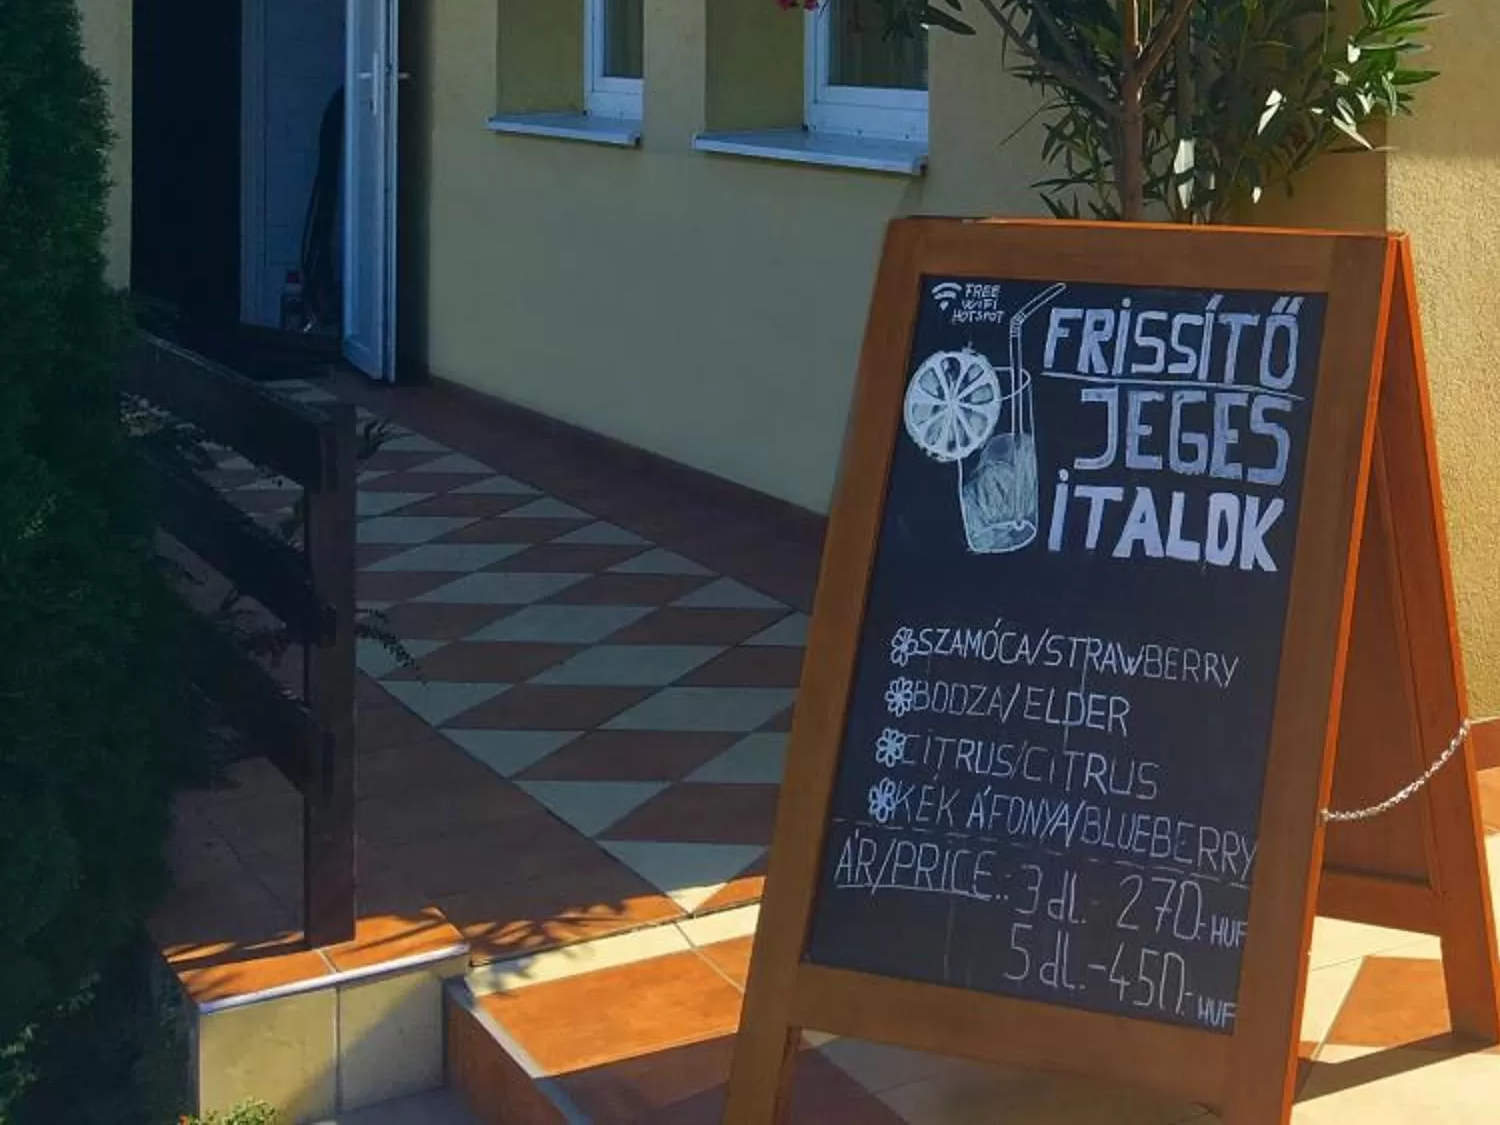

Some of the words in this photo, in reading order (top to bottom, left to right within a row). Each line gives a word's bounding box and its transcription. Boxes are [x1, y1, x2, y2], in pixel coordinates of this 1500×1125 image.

[965, 283, 1000, 299] FREE
[961, 298, 998, 310] WIFI
[952, 308, 1004, 324] HOTSPOT
[1073, 385, 1293, 485] JEGES
